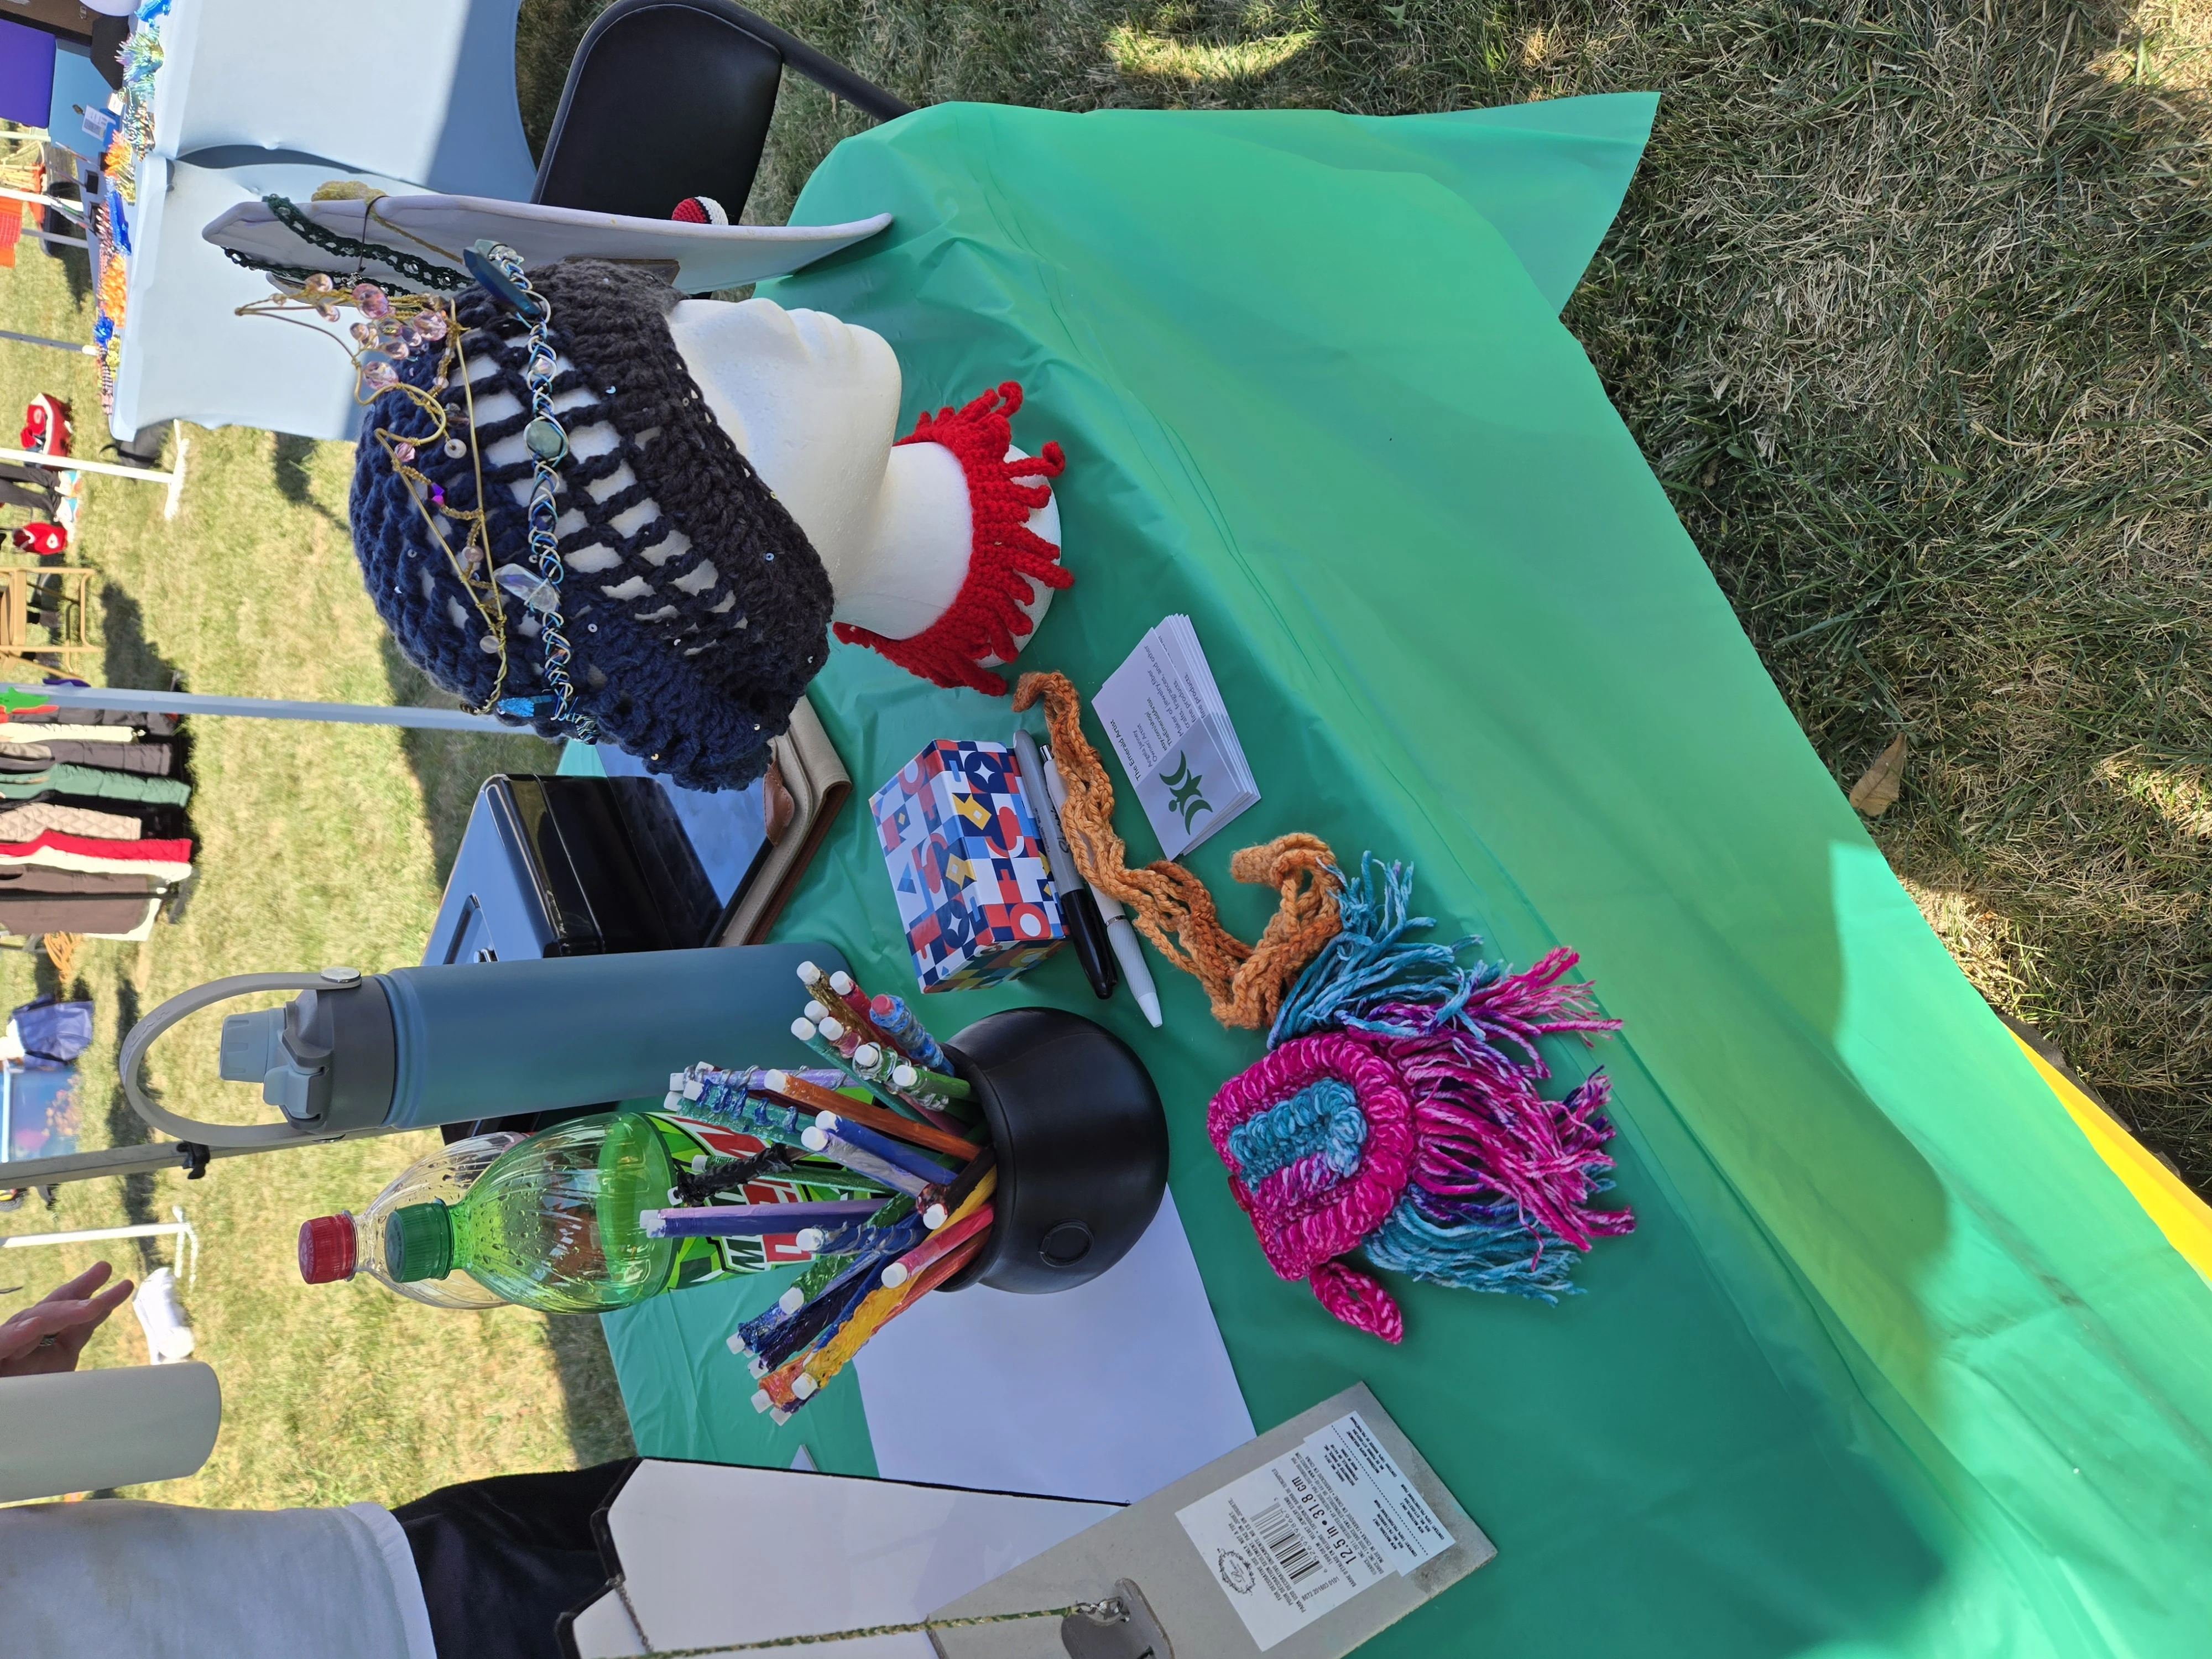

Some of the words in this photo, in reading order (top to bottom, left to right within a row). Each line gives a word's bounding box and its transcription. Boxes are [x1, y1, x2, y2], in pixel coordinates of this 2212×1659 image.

[1144, 645, 1155, 662] other
[1152, 662, 1162, 675] and
[1161, 674, 1180, 710] fragrances,
[1173, 678, 1191, 709] products.
[1184, 672, 1202, 705] products.
[1166, 707, 1173, 715] of
[1179, 708, 1190, 729] crafts,
[1188, 708, 1197, 723] fine
[1198, 704, 1206, 719] fine
[1110, 719, 1122, 738] Artist
[1146, 697, 1172, 747] TheEmeraldArtist
[1171, 716, 1184, 737] Maker
[1132, 729, 1145, 750] Janney
[1137, 723, 1147, 740] Artist
[1144, 711, 1167, 752] etsy.com/shop/
[1118, 738, 1135, 767] Emerald
[1141, 748, 1153, 768] Angela
[1144, 739, 1157, 763] Owner/
[1133, 765, 1141, 782] The
[1305, 1455, 1315, 1468] CHINA
[1291, 1476, 1307, 1492] cm
[1284, 1496, 1295, 1510] STAND
[1301, 1494, 1325, 1519] 31.8
[1333, 1495, 1344, 1507] CHINE
[1280, 1507, 1300, 1533] 98667
[1292, 1509, 1307, 1526] JEWELRY
[1237, 1535, 1245, 1545] NOT
[1242, 1531, 1250, 1541] PAS
[1304, 1526, 1316, 1540] VELVET
[1327, 1526, 1339, 1539] in
[1349, 1528, 1360, 1541] DARICE
[1361, 1533, 1372, 1546] CHINA
[1299, 1535, 1319, 1561] 52695
[1317, 1534, 1331, 1551] VELOURS
[1333, 1538, 1357, 1565] 12.5
[1373, 1551, 1384, 1563] MADE
[1250, 1556, 1259, 1567] USE
[1256, 1566, 1276, 1592] DECORATIVE
[1272, 1564, 1292, 1591] DECORATIVO
[1345, 1574, 1357, 1588] BARRE
[1274, 1590, 1282, 1601] FOR
[1282, 1592, 1293, 1606] POUR
[1289, 1590, 1298, 1601] USO
[1296, 1599, 1306, 1613] PARA
